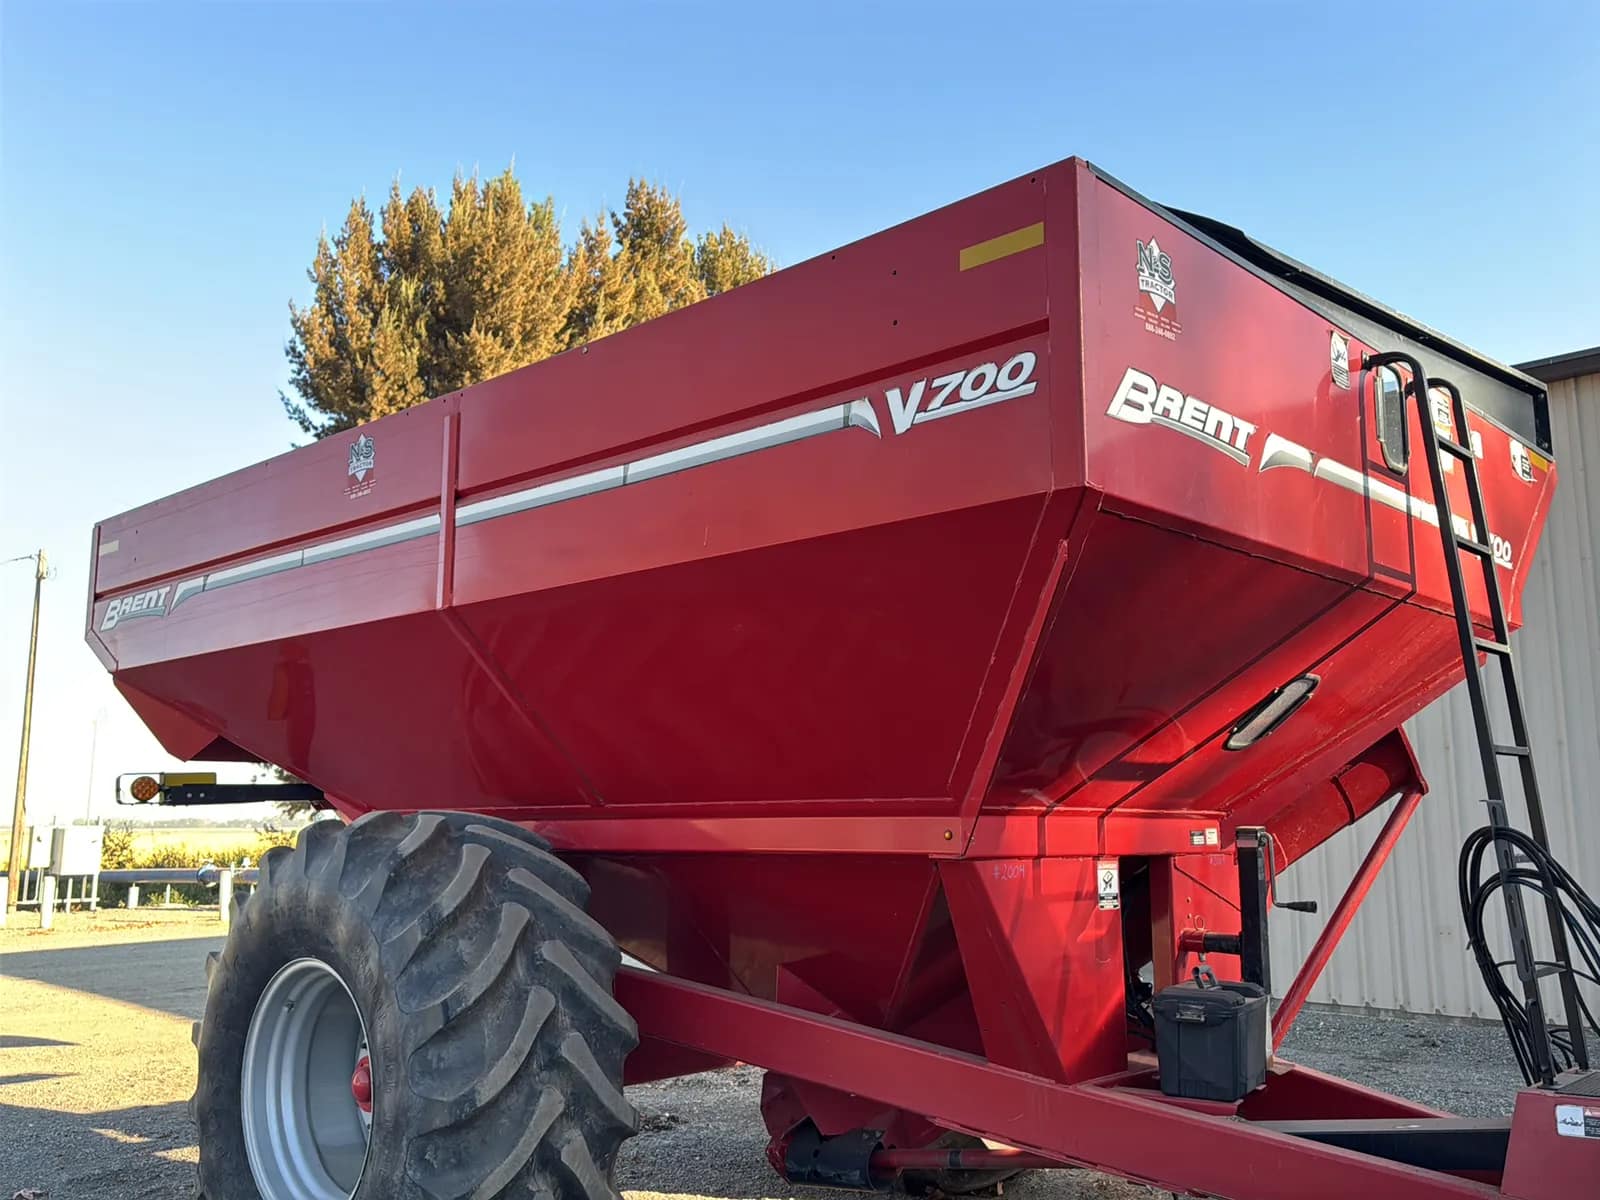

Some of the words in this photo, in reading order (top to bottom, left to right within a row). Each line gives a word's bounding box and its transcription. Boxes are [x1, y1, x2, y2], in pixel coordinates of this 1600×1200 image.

[1136, 239, 1174, 287] N&S
[1140, 278, 1174, 299] TRACTOR
[885, 352, 1038, 435] V700
[1103, 366, 1259, 454] BRENT
[100, 585, 171, 632] BRENT
